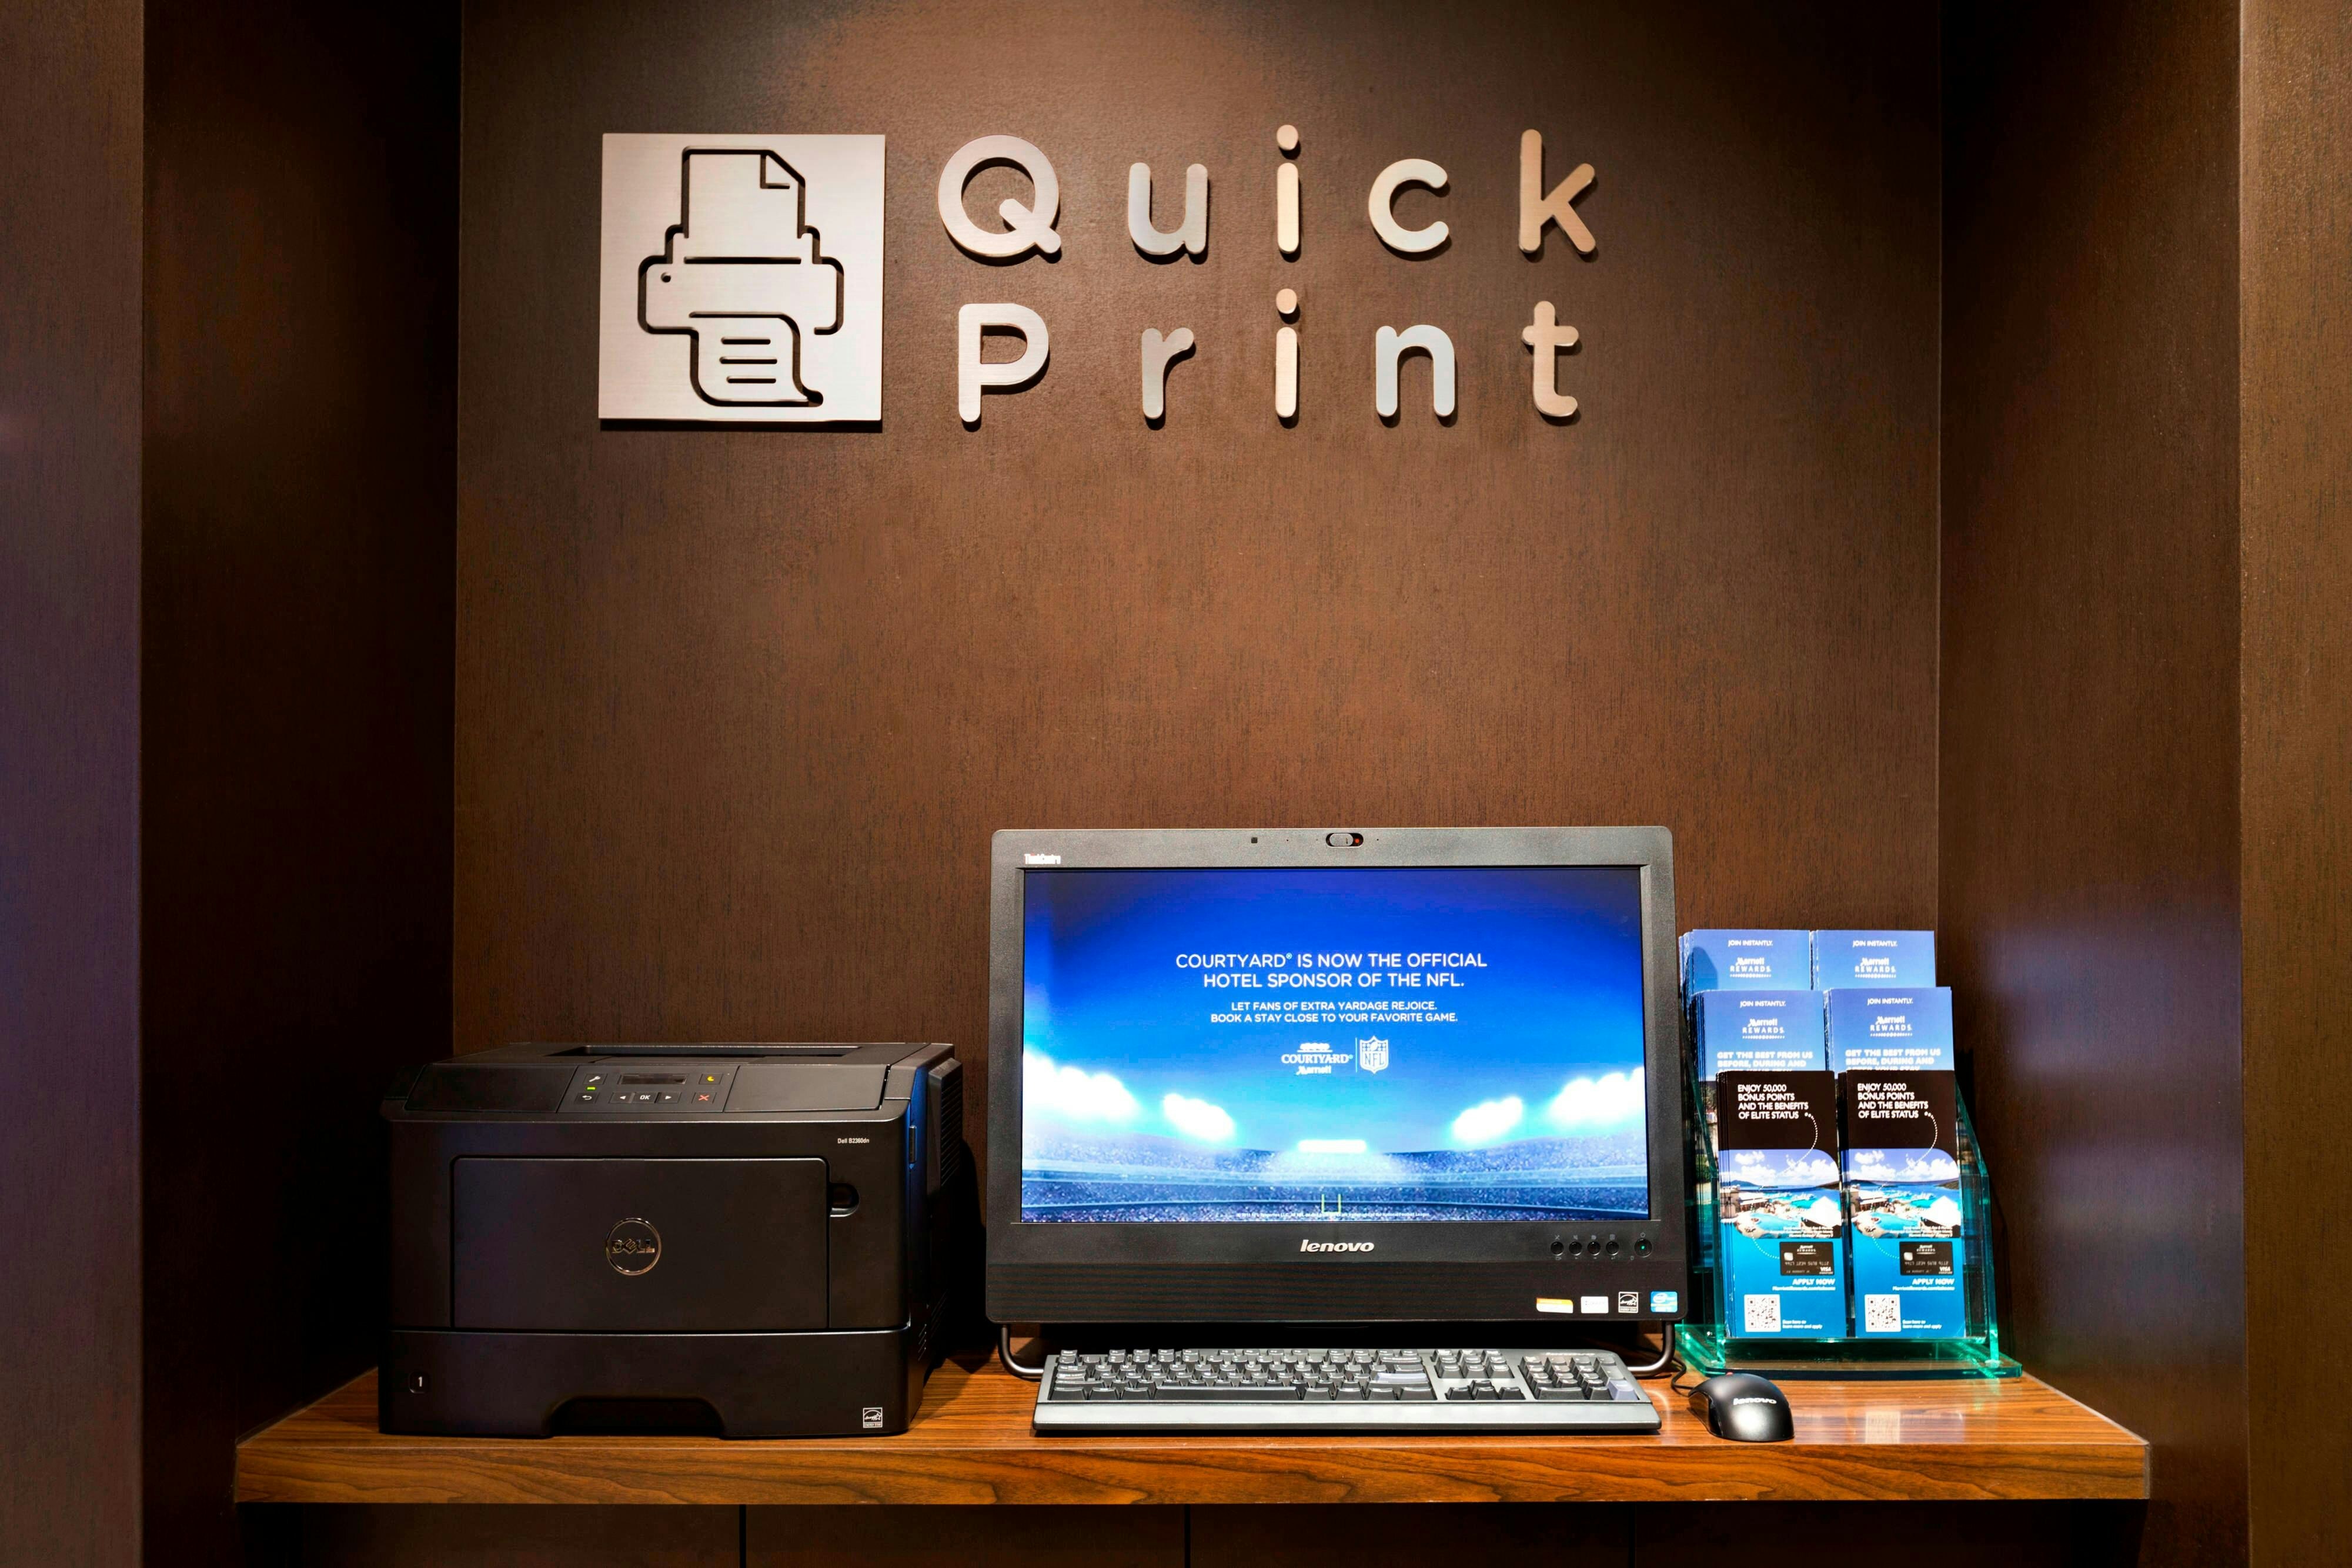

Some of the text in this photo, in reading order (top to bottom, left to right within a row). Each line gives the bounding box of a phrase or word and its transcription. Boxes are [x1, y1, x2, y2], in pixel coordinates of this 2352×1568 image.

[938, 125, 1596, 258] Quick
[958, 288, 1579, 423] Print
[1298, 953, 1313, 968] IS
[1318, 953, 1363, 968] NOW
[1368, 953, 1402, 967] THE
[1406, 952, 1487, 968] OFFICIAL
[1204, 972, 1464, 988] HOTEL SPONSOR OF THE NFL.
[1231, 1001, 1437, 1011] LET FANS OF EXTRA YARDAGE REJOICE.
[1211, 1012, 1458, 1022] BOOK A STAY CLOSE TO YOUR FAVORITE GAME.
[1364, 1054, 1385, 1065] NFL
[1737, 1084, 1788, 1094] ENJOY 50,000
[1857, 1082, 1907, 1094] ENJOY 50,000
[1738, 1093, 1795, 1101] BONUS POINTS
[1857, 1092, 1915, 1101] BONUS POINTS
[1738, 1101, 1809, 1111] AND THE BENEFITS
[1857, 1101, 1929, 1109] AND THE BENEFITS
[1738, 1111, 1799, 1119] OF ELITE STATUS
[1858, 1109, 1919, 1119] OF ELITE STATUS
[612, 1238, 655, 1254] DELL
[1300, 1239, 1375, 1252] lenovo
[418, 1376, 423, 1388] 1
[1733, 1398, 1777, 1406] lenovo
